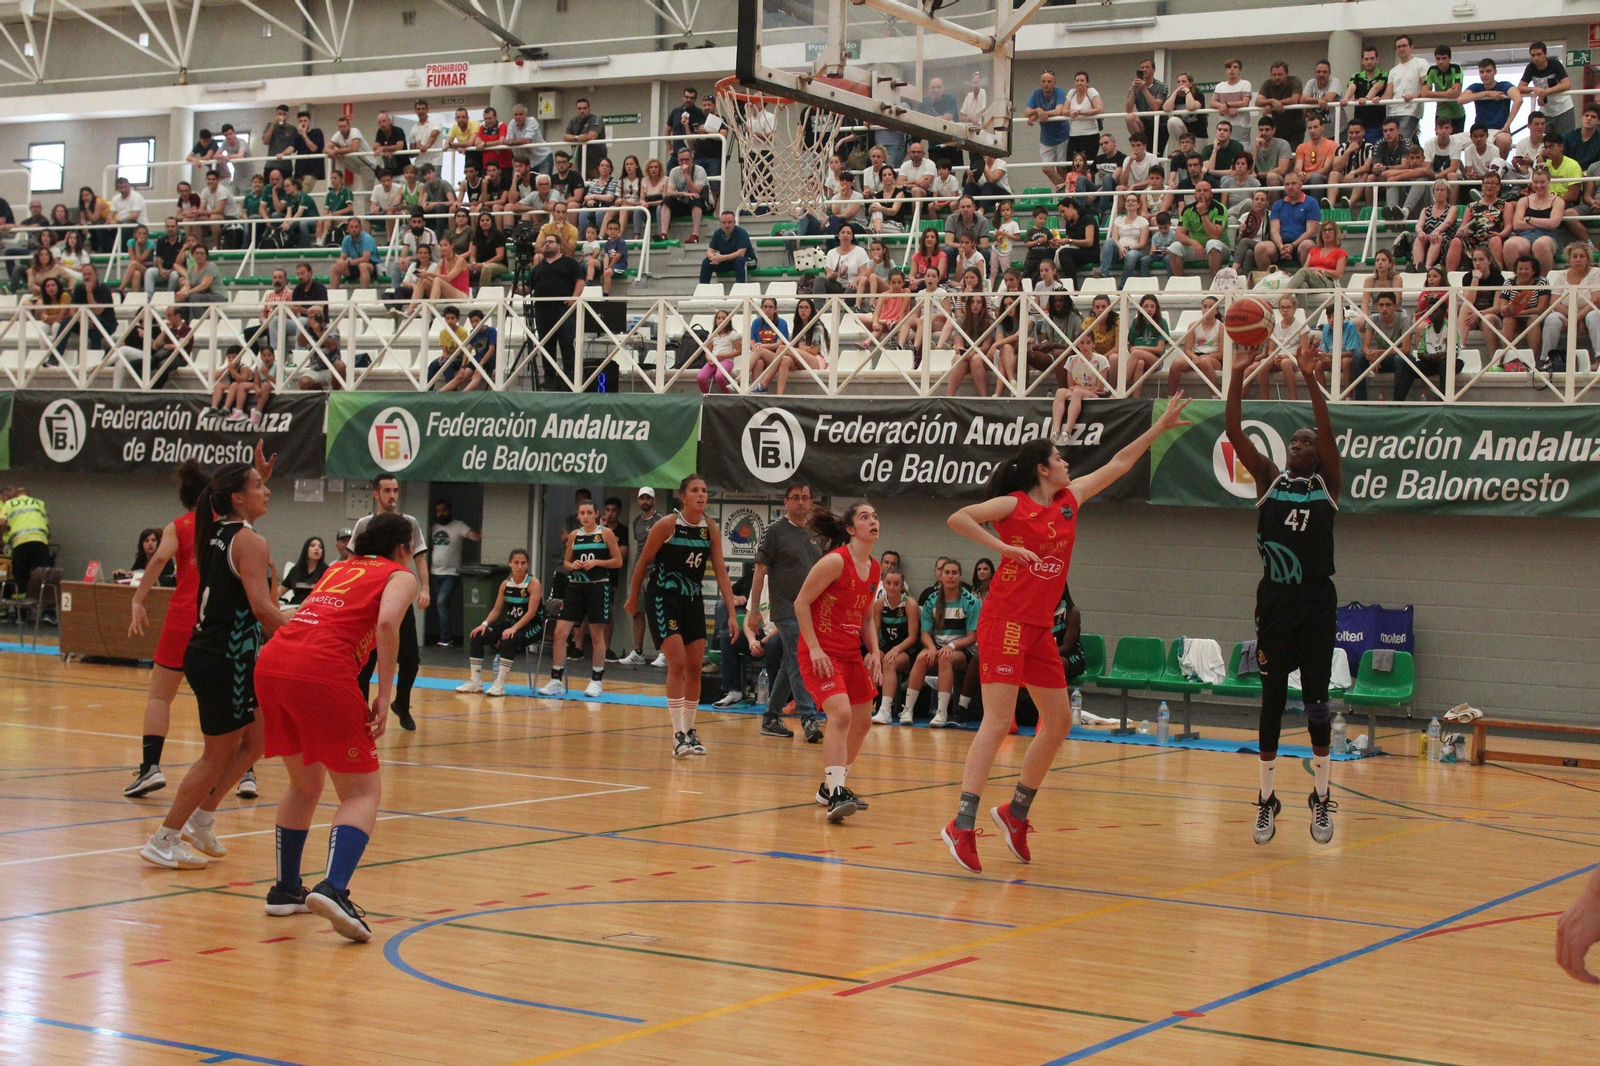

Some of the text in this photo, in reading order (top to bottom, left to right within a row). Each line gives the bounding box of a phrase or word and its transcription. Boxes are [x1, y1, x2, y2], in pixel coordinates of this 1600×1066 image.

[808, 42, 857, 51] Prodo
[427, 63, 468, 73] PROHIBIDO
[427, 73, 466, 87] FUMAR
[91, 403, 191, 432] Federación
[426, 411, 650, 441] Federación Andaluza
[814, 413, 1104, 446] Federación Andalza
[123, 437, 254, 464] de Baloncesto
[1335, 428, 1600, 462] deración Andaluz
[461, 445, 608, 474] de Baloncesto
[860, 453, 1001, 486] de Balonc
[1351, 468, 1570, 503] de Baloncesto
[1047, 521, 1057, 538] 5
[1284, 508, 1310, 531] 47
[686, 552, 703, 568] 46
[313, 566, 366, 595] 12
[64, 596, 70, 608] 2
[853, 594, 868, 609] 18
[511, 607, 524, 618] 40
[819, 592, 838, 634] MARISTAS
[886, 627, 898, 640] 15
[1336, 630, 1365, 642] olten
[1380, 632, 1407, 644] molten
